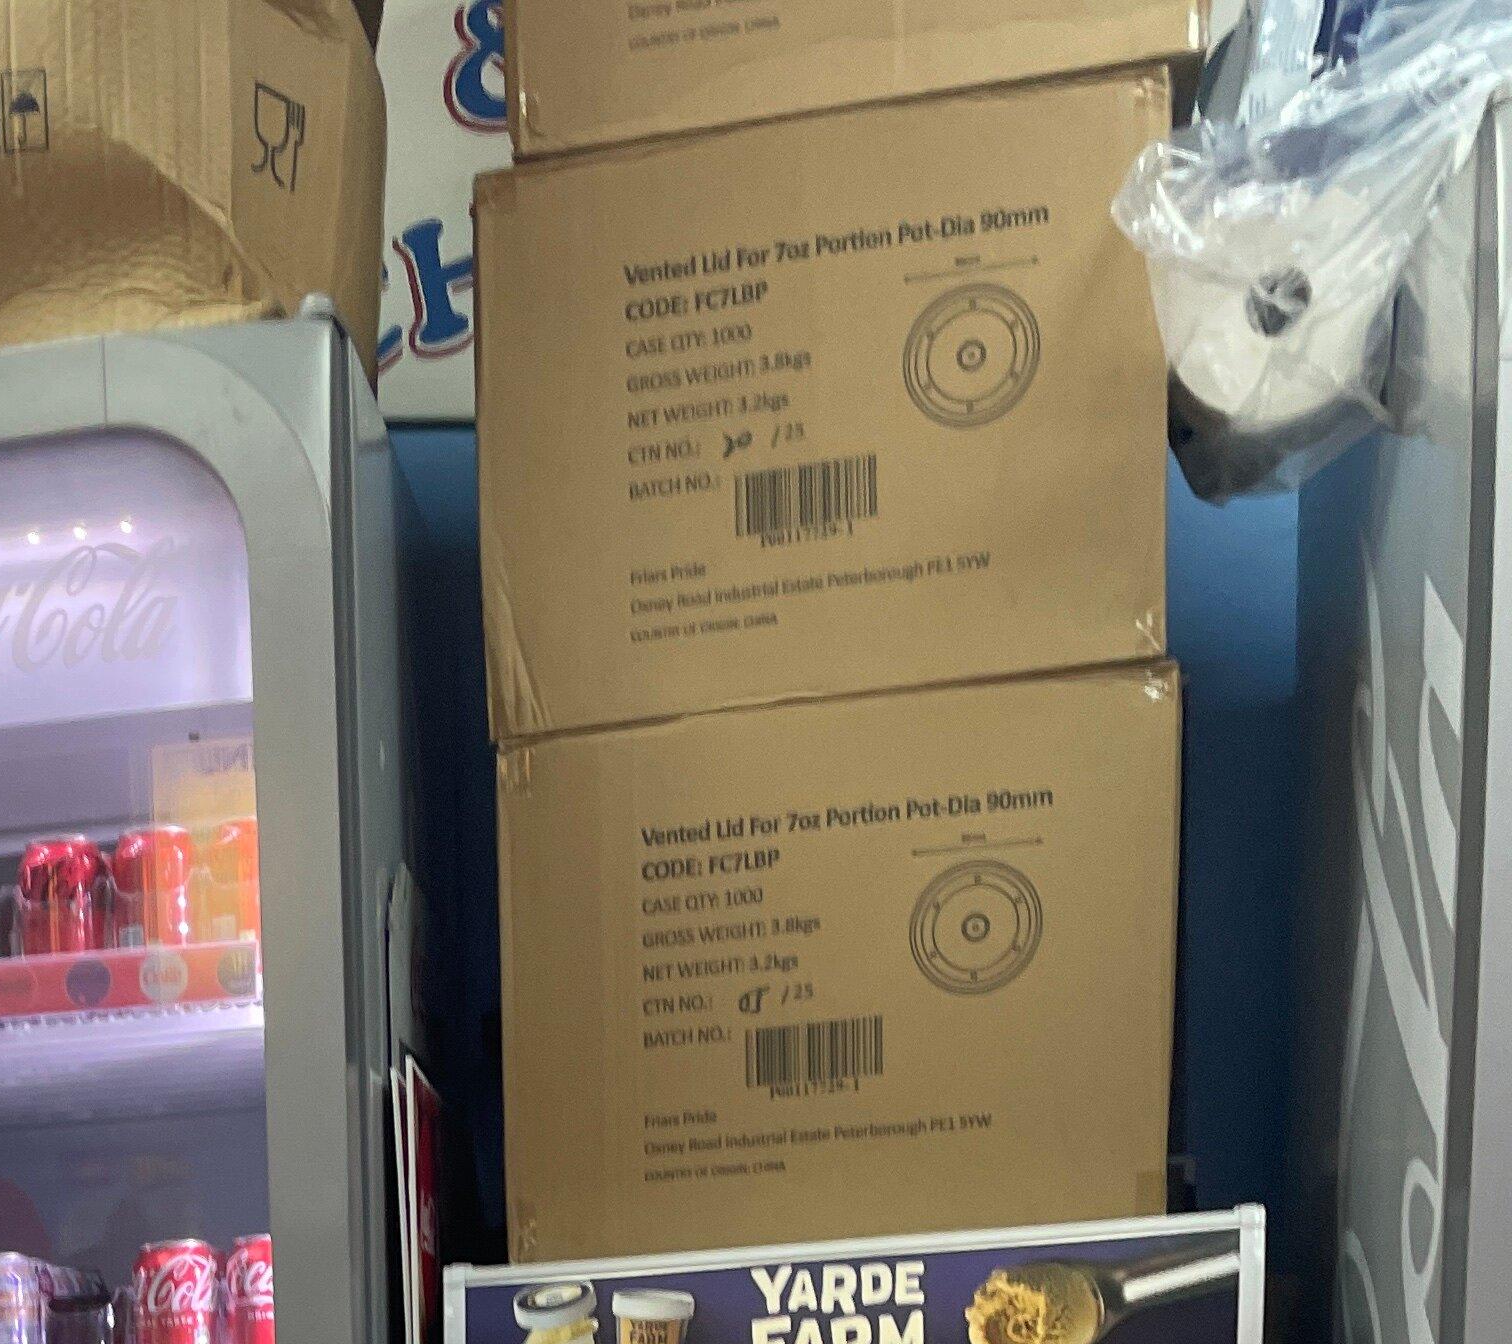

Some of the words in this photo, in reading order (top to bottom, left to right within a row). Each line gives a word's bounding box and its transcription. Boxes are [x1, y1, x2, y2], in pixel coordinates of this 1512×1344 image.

[624, 256, 696, 285] Vented
[702, 250, 730, 273] Lid
[737, 248, 769, 269] For
[774, 240, 809, 262] 7oz
[815, 230, 892, 256] Portion
[898, 215, 976, 244] Pot-Dia
[980, 205, 1049, 232] 90mm
[625, 296, 687, 321] CODE:
[695, 281, 768, 313] FC7LBP
[626, 337, 665, 358] CASE
[713, 323, 753, 345] 1000
[626, 370, 681, 393] GROSS
[684, 359, 755, 385] WEIGHT:
[627, 408, 658, 429] NET
[627, 443, 661, 464] CTN
[628, 476, 681, 500] BATCH
[827, 561, 923, 588] Peterborough
[641, 818, 711, 847] Vented
[716, 816, 744, 839] Lid
[750, 815, 780, 836] For
[788, 811, 820, 833] 7oz
[827, 803, 900, 828] Portion
[906, 794, 981, 820] Pot-Dia
[987, 789, 1053, 810] 90mm
[642, 857, 702, 881] CODE:
[709, 848, 780, 875] FC7LBP
[642, 896, 681, 916] CASE
[725, 887, 763, 907] 1000
[642, 928, 695, 948] GROSS
[699, 920, 765, 943] WEIGHT:
[643, 963, 672, 983] NET
[677, 957, 744, 980] WEIGHT:
[643, 998, 675, 1017] CTN
[643, 1028, 693, 1049] BATCH
[834, 1118, 927, 1139] Peterborough
[749, 1260, 925, 1315] YARDE
